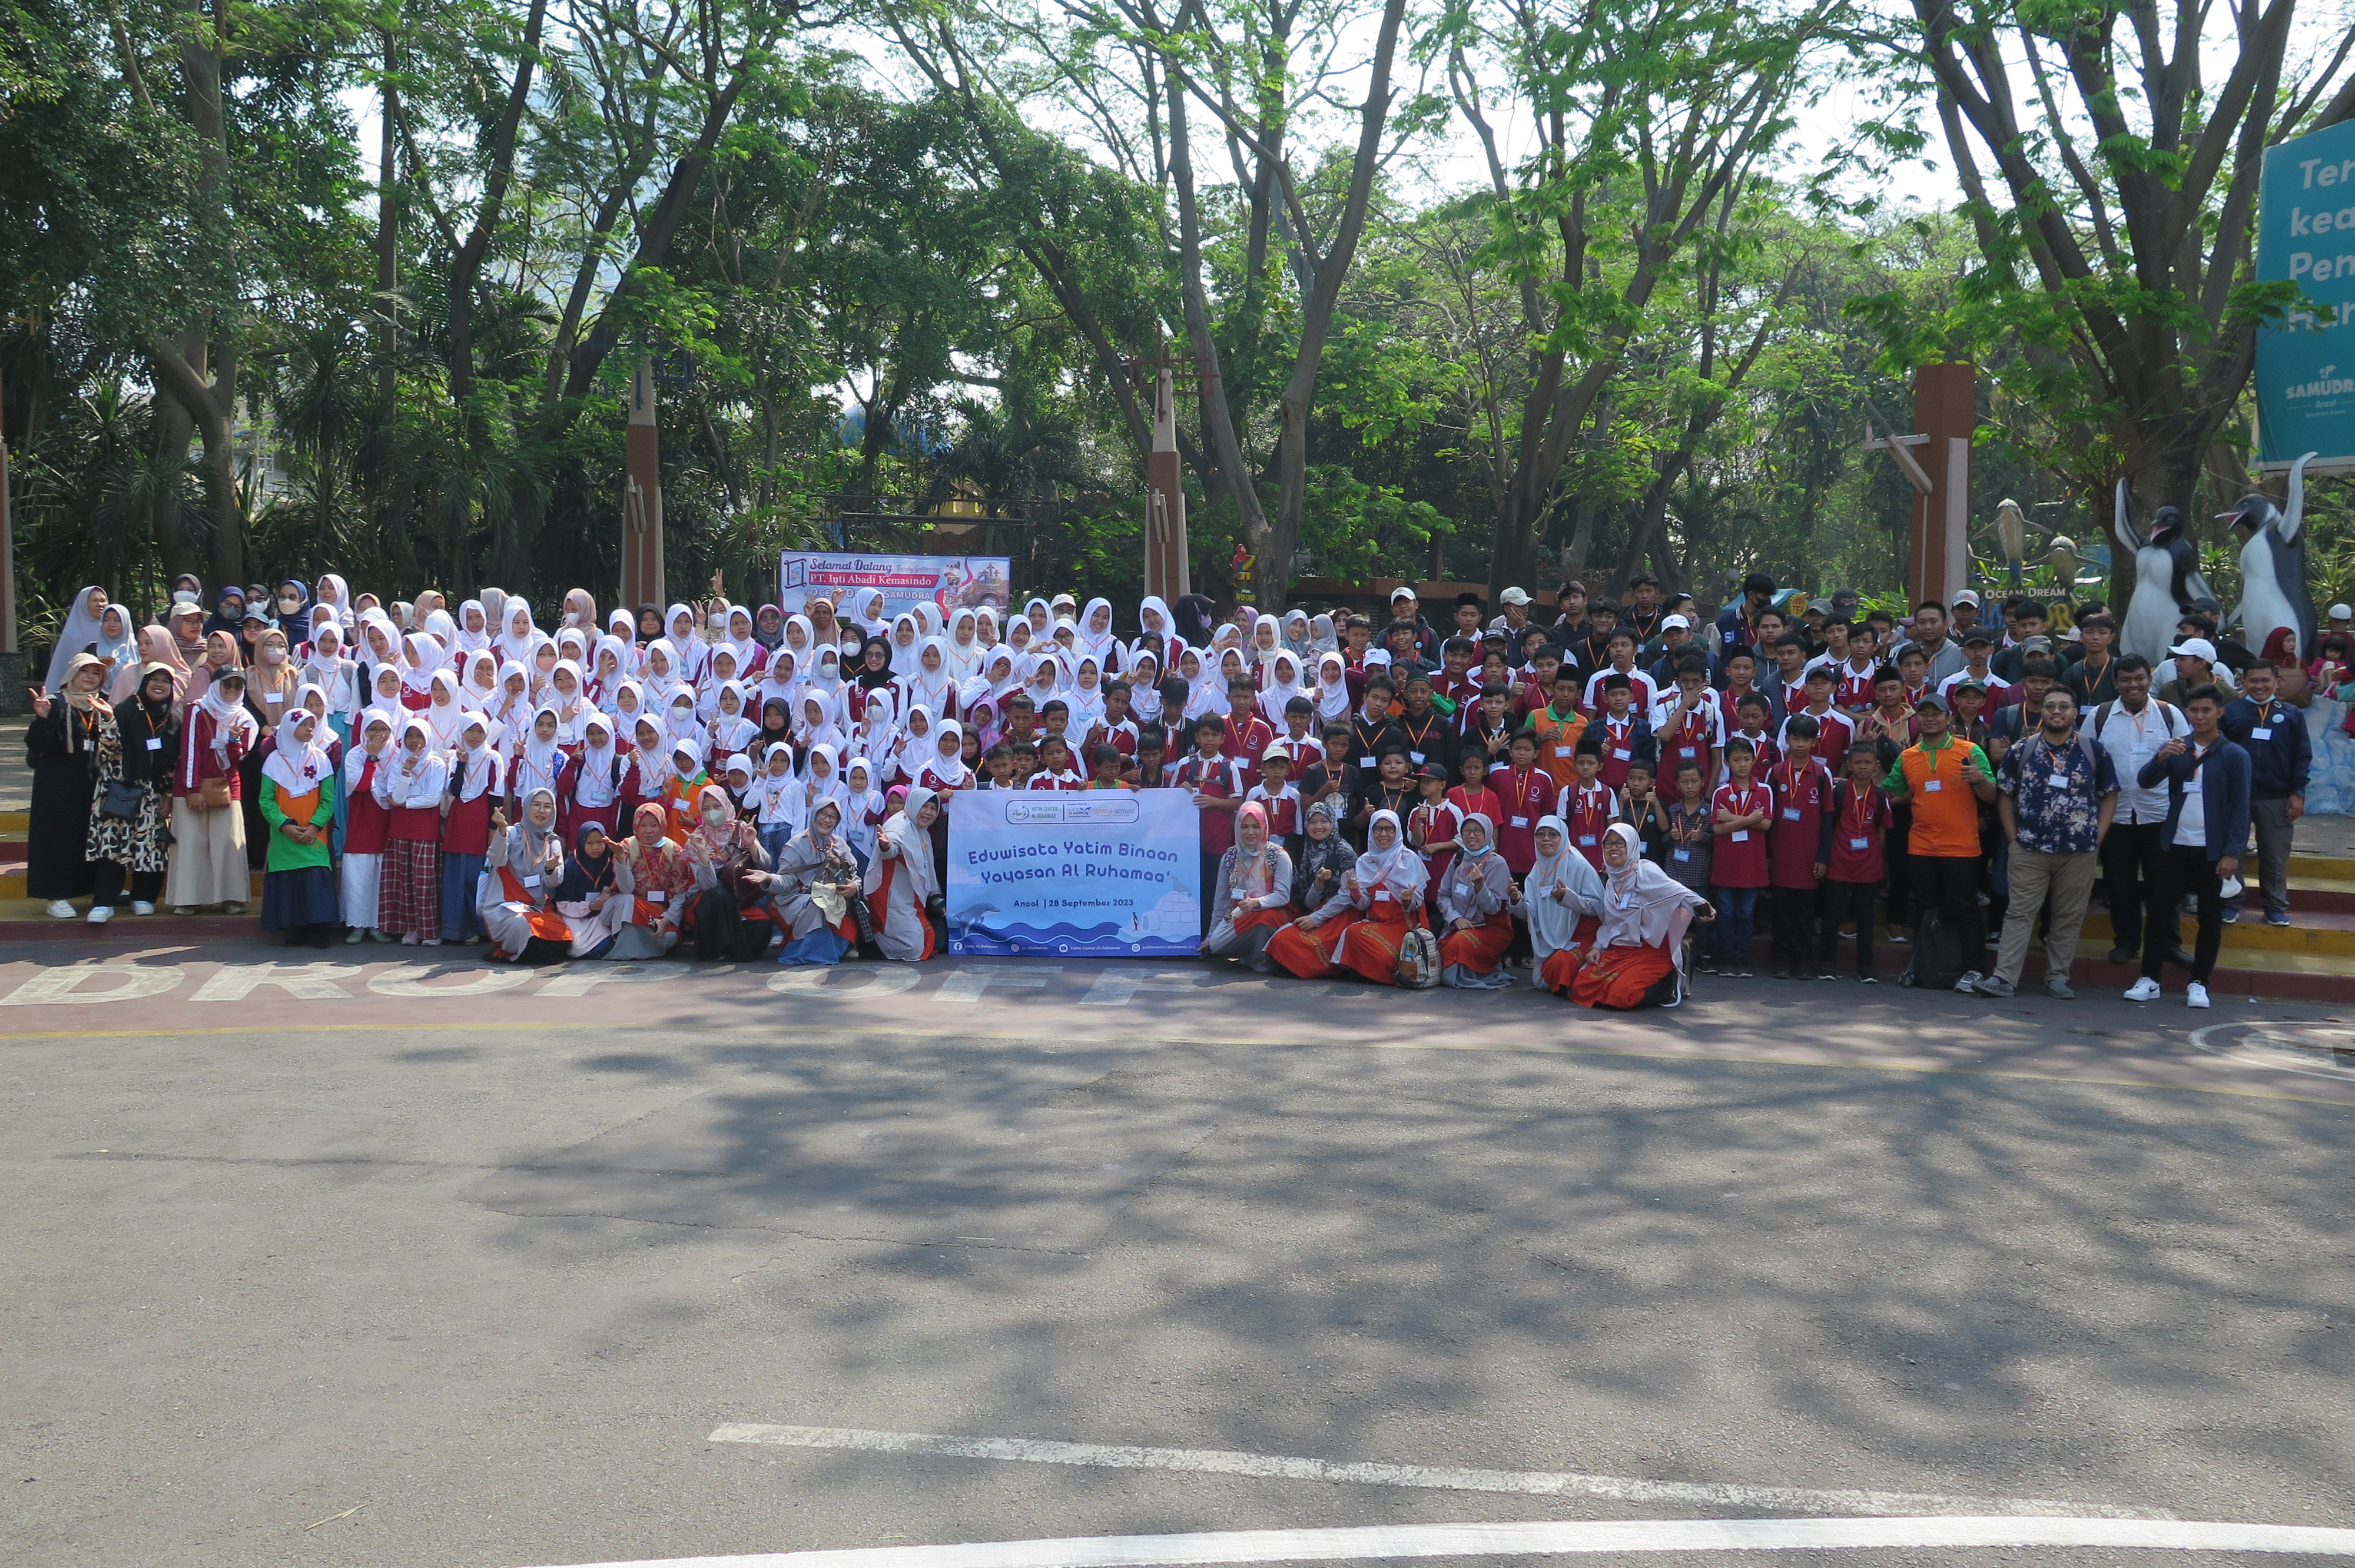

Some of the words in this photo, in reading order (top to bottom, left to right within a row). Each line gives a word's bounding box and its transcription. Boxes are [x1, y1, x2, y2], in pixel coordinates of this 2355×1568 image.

[2286, 378, 2355, 399] SAMUDR
[810, 559, 852, 570] Selamat
[854, 559, 893, 576] Datang
[810, 573, 826, 582] PT.
[829, 574, 845, 583] Inti
[848, 575, 876, 583] Abadi
[879, 576, 931, 586] Kemasindo
[883, 590, 931, 600] SAMUDRA
[2027, 587, 2065, 598] DREAM
[968, 843, 1058, 865] Eduwisata
[1063, 841, 1112, 856] Yatim
[1119, 843, 1178, 863] Binaan
[981, 867, 1056, 884] Yayasan
[1062, 864, 1079, 876] Al
[1062, 899, 1110, 908] September
[1113, 899, 1134, 907] 2023
[767, 963, 1212, 1006] OFF
